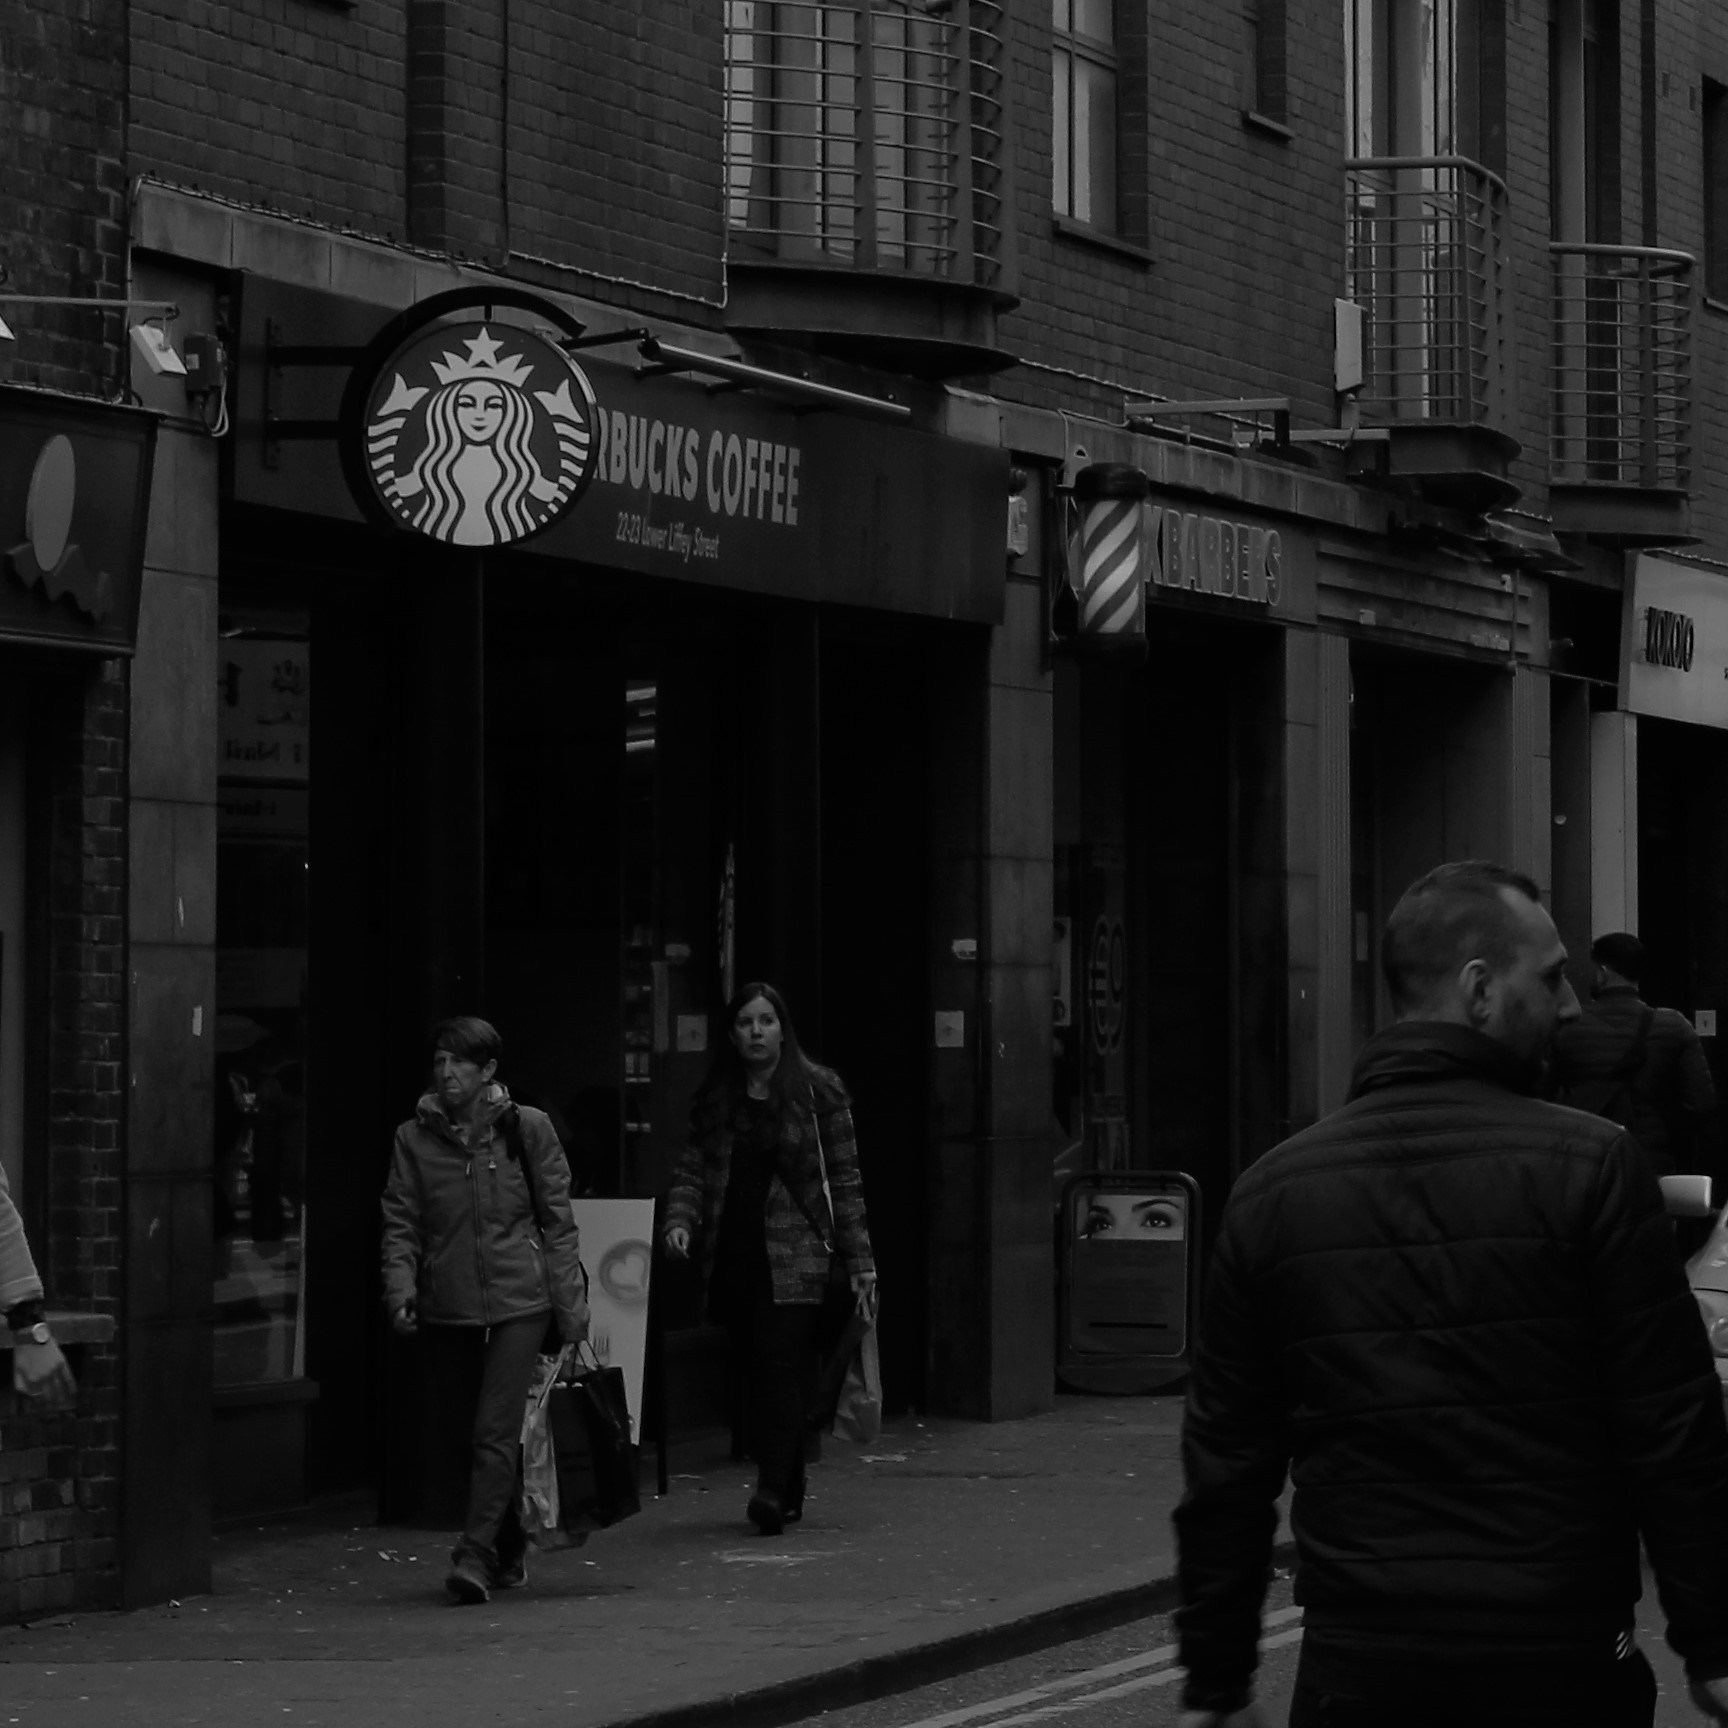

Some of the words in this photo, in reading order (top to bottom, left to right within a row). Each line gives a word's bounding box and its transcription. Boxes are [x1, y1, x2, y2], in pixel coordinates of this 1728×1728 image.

[593, 406, 700, 502] RBUCKS
[706, 429, 800, 526] COFFEE
[1163, 508, 1281, 607] BARBERS
